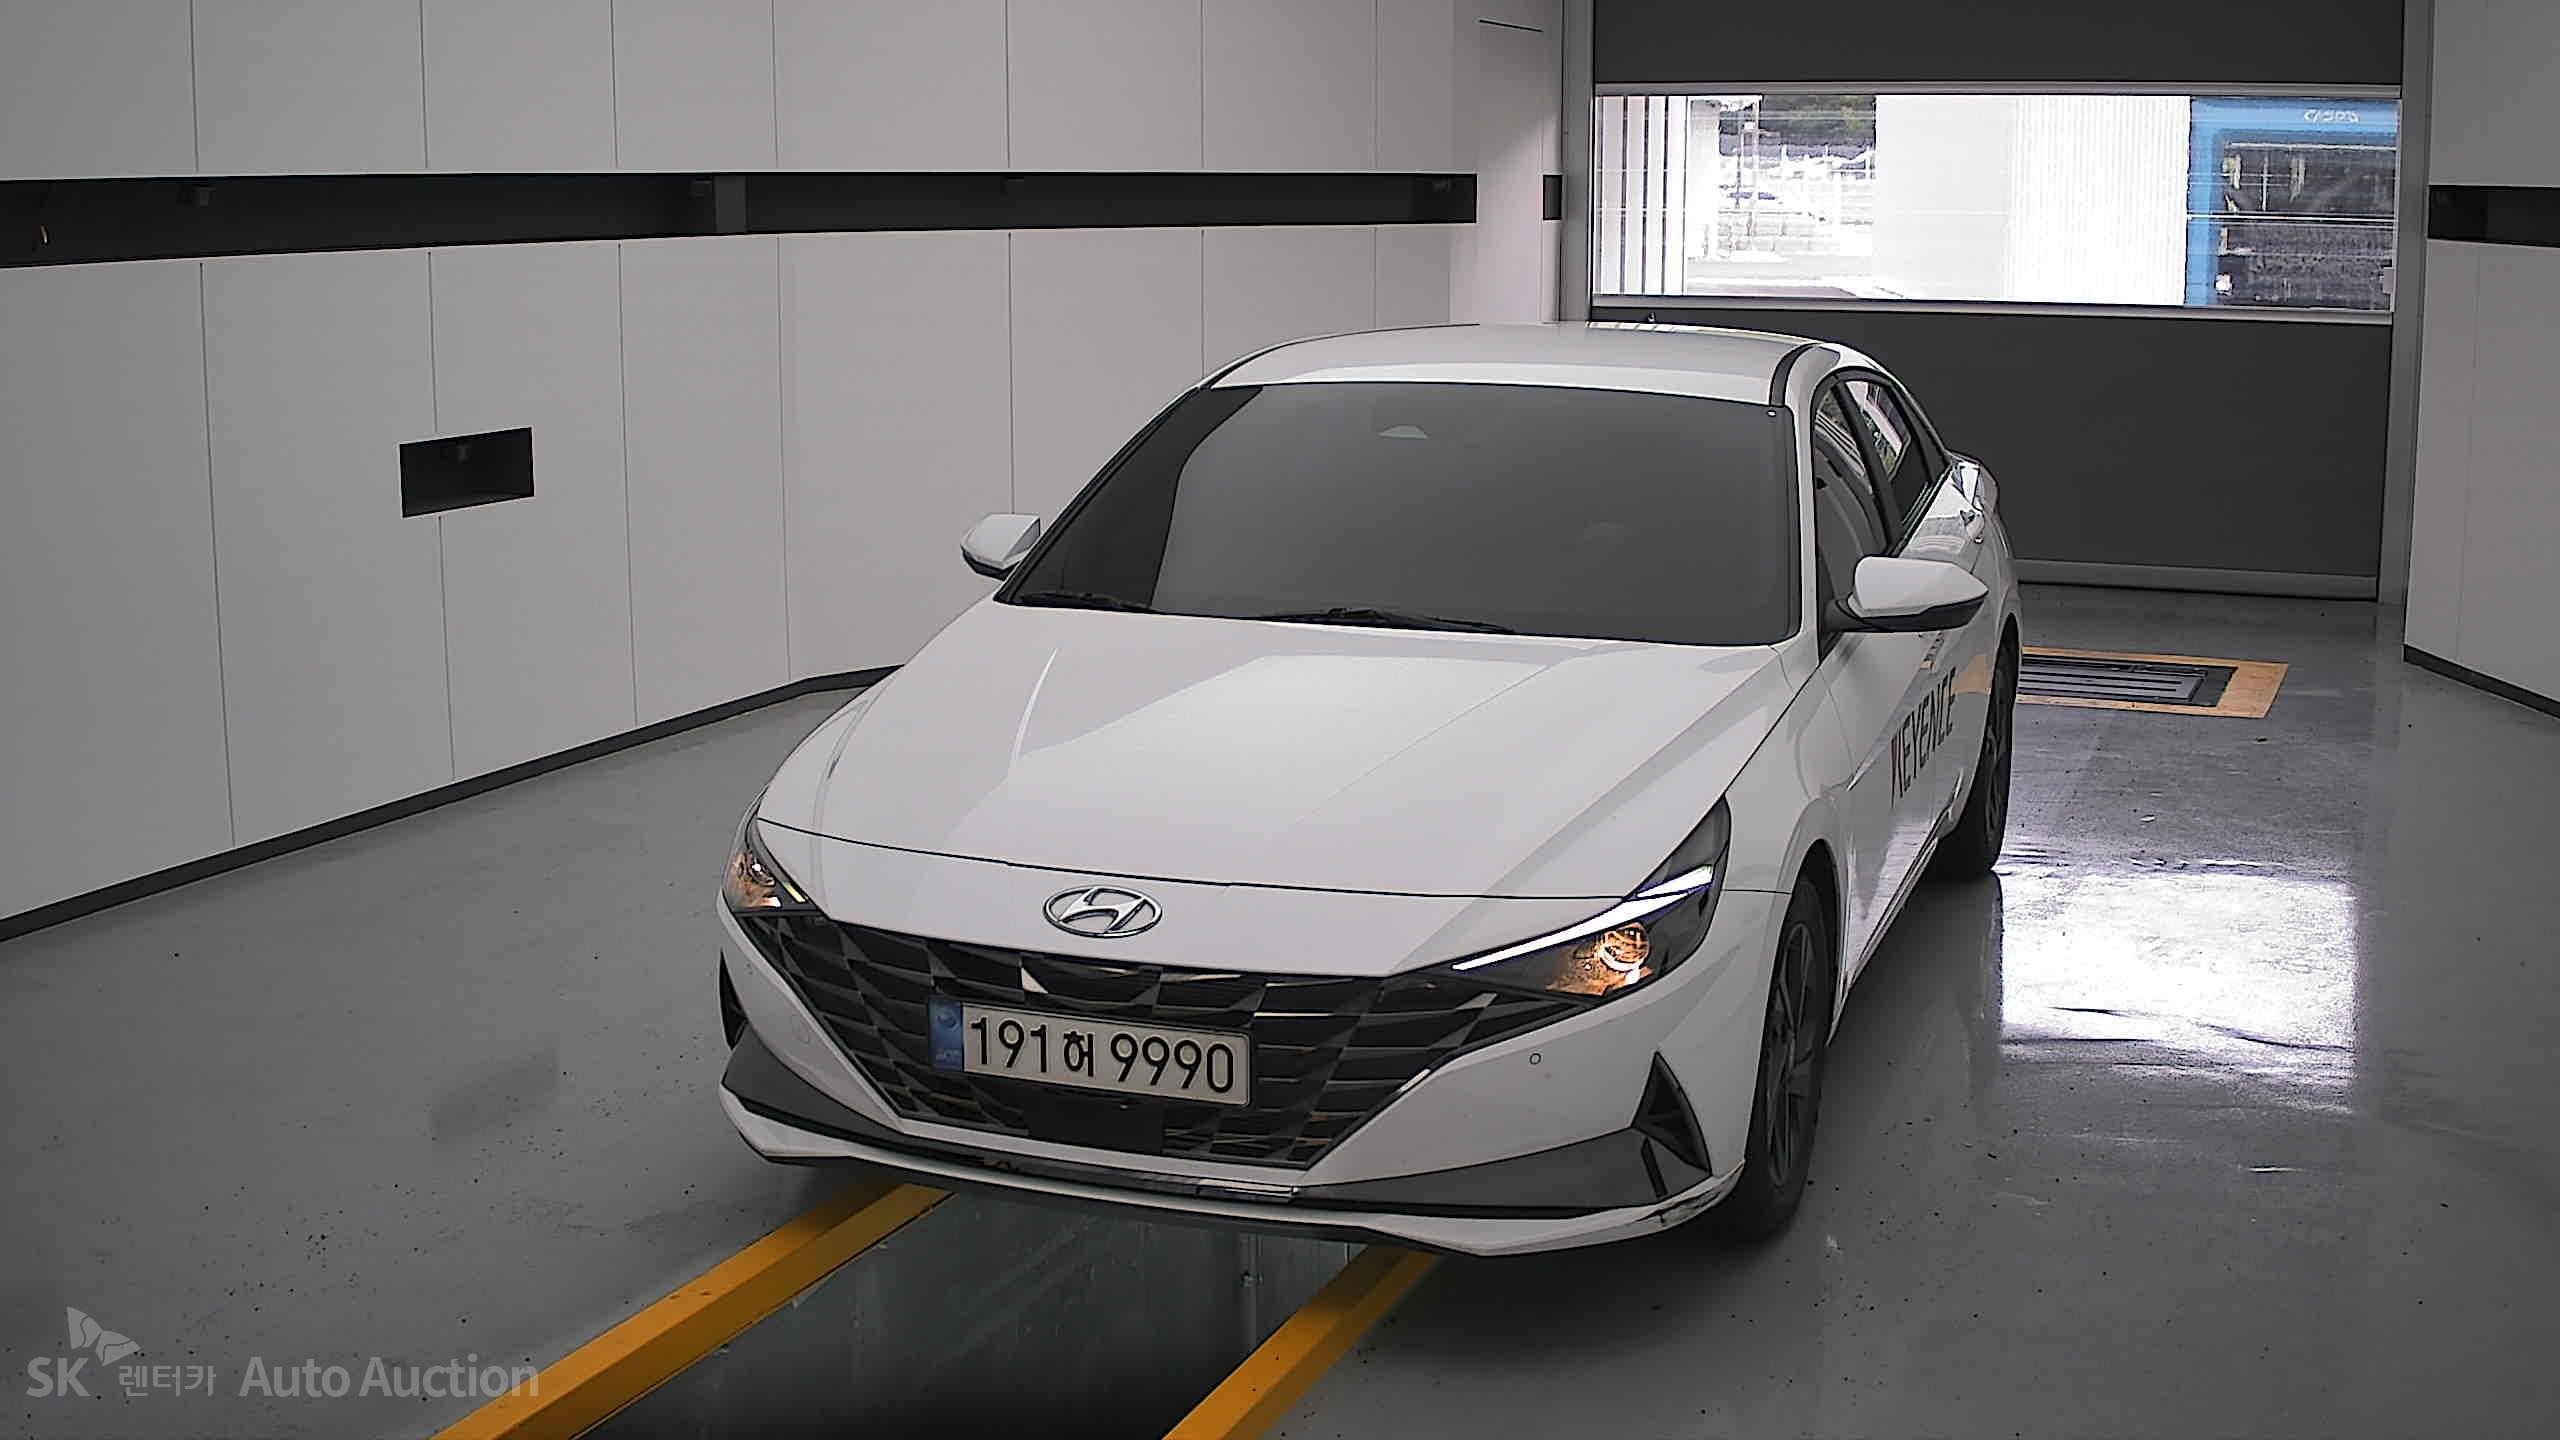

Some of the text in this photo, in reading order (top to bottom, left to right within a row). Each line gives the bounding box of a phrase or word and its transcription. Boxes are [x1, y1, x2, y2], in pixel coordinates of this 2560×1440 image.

[1891, 665, 1957, 808] KEYENCE
[970, 1016, 1234, 1094] 191허 9990
